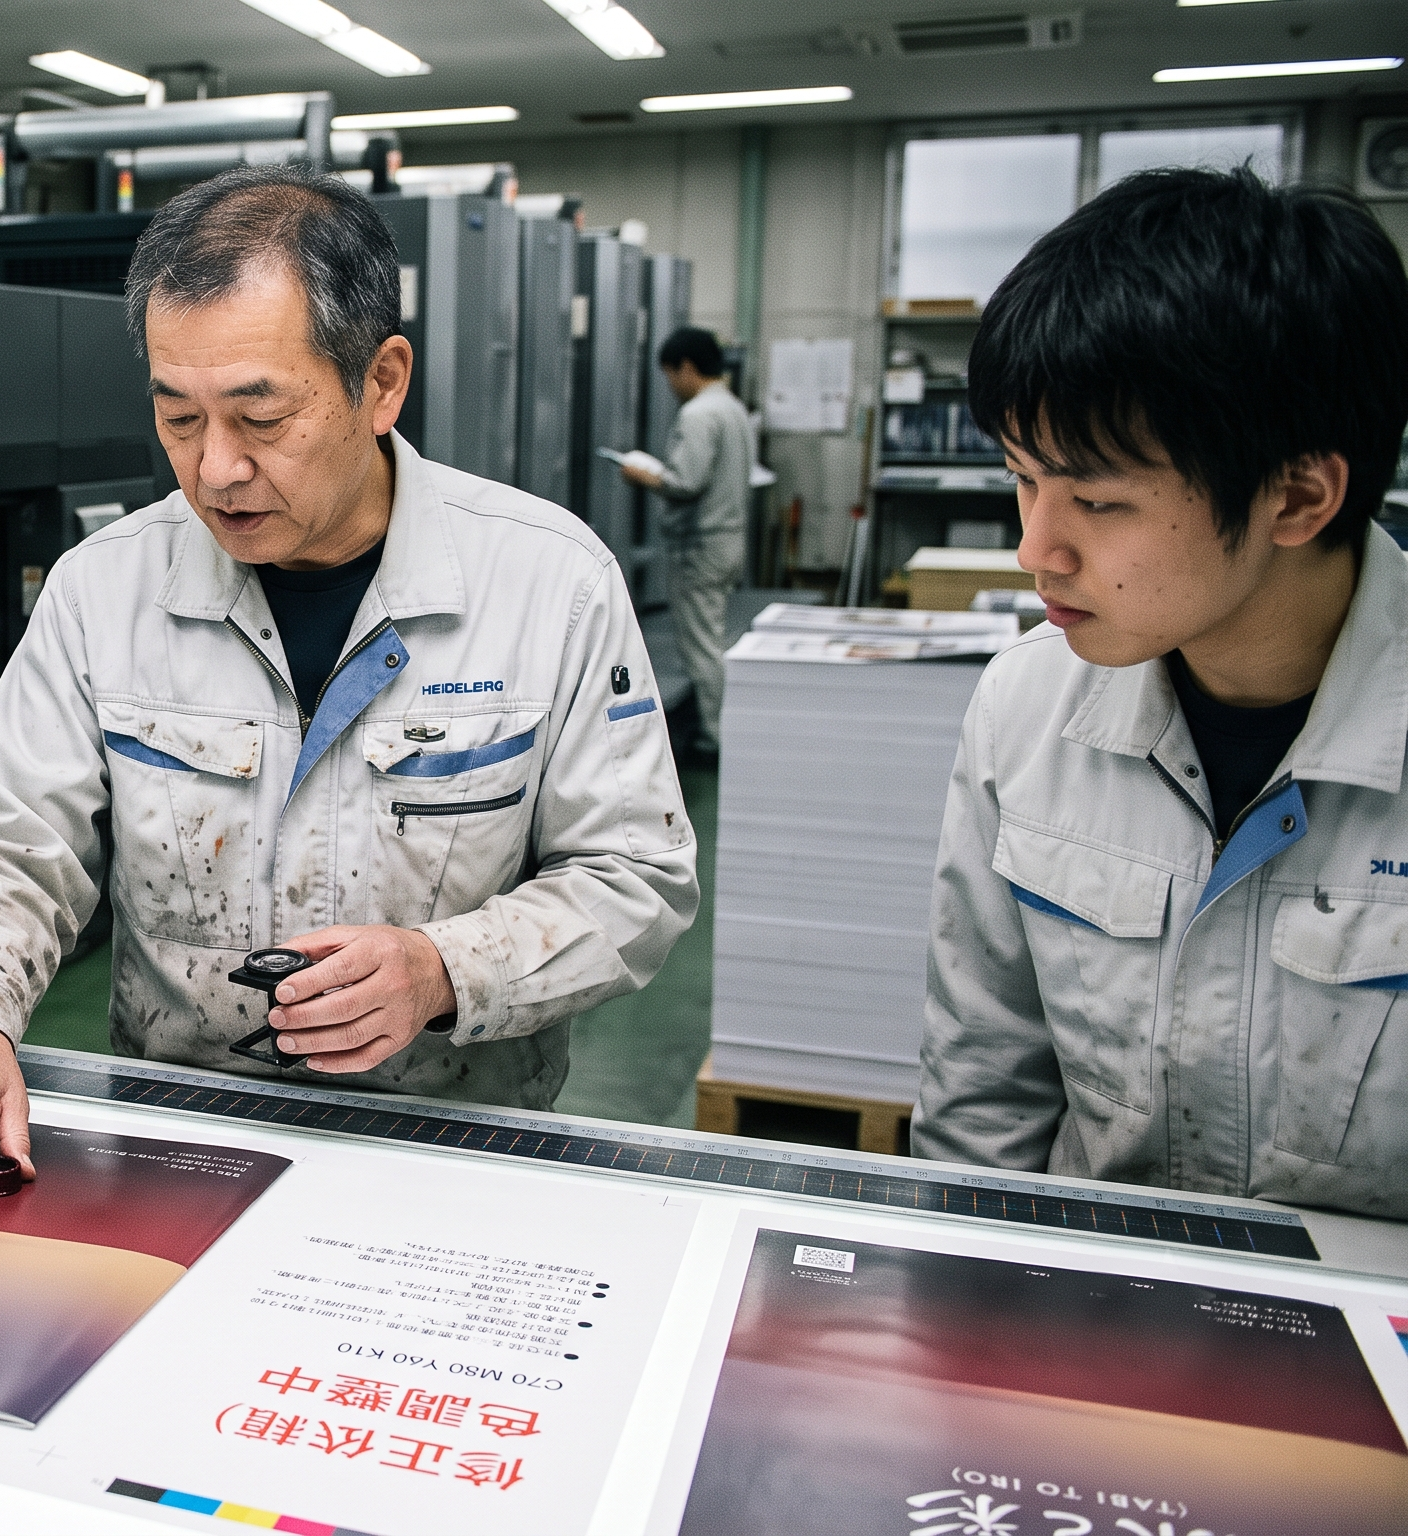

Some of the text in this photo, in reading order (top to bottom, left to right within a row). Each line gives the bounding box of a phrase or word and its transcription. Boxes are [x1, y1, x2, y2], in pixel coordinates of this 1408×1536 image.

[337, 1341, 565, 1391] C70 M80 Y60 K10
[257, 1365, 542, 1439] 色調整中
[1035, 1482, 1083, 1501] TO
